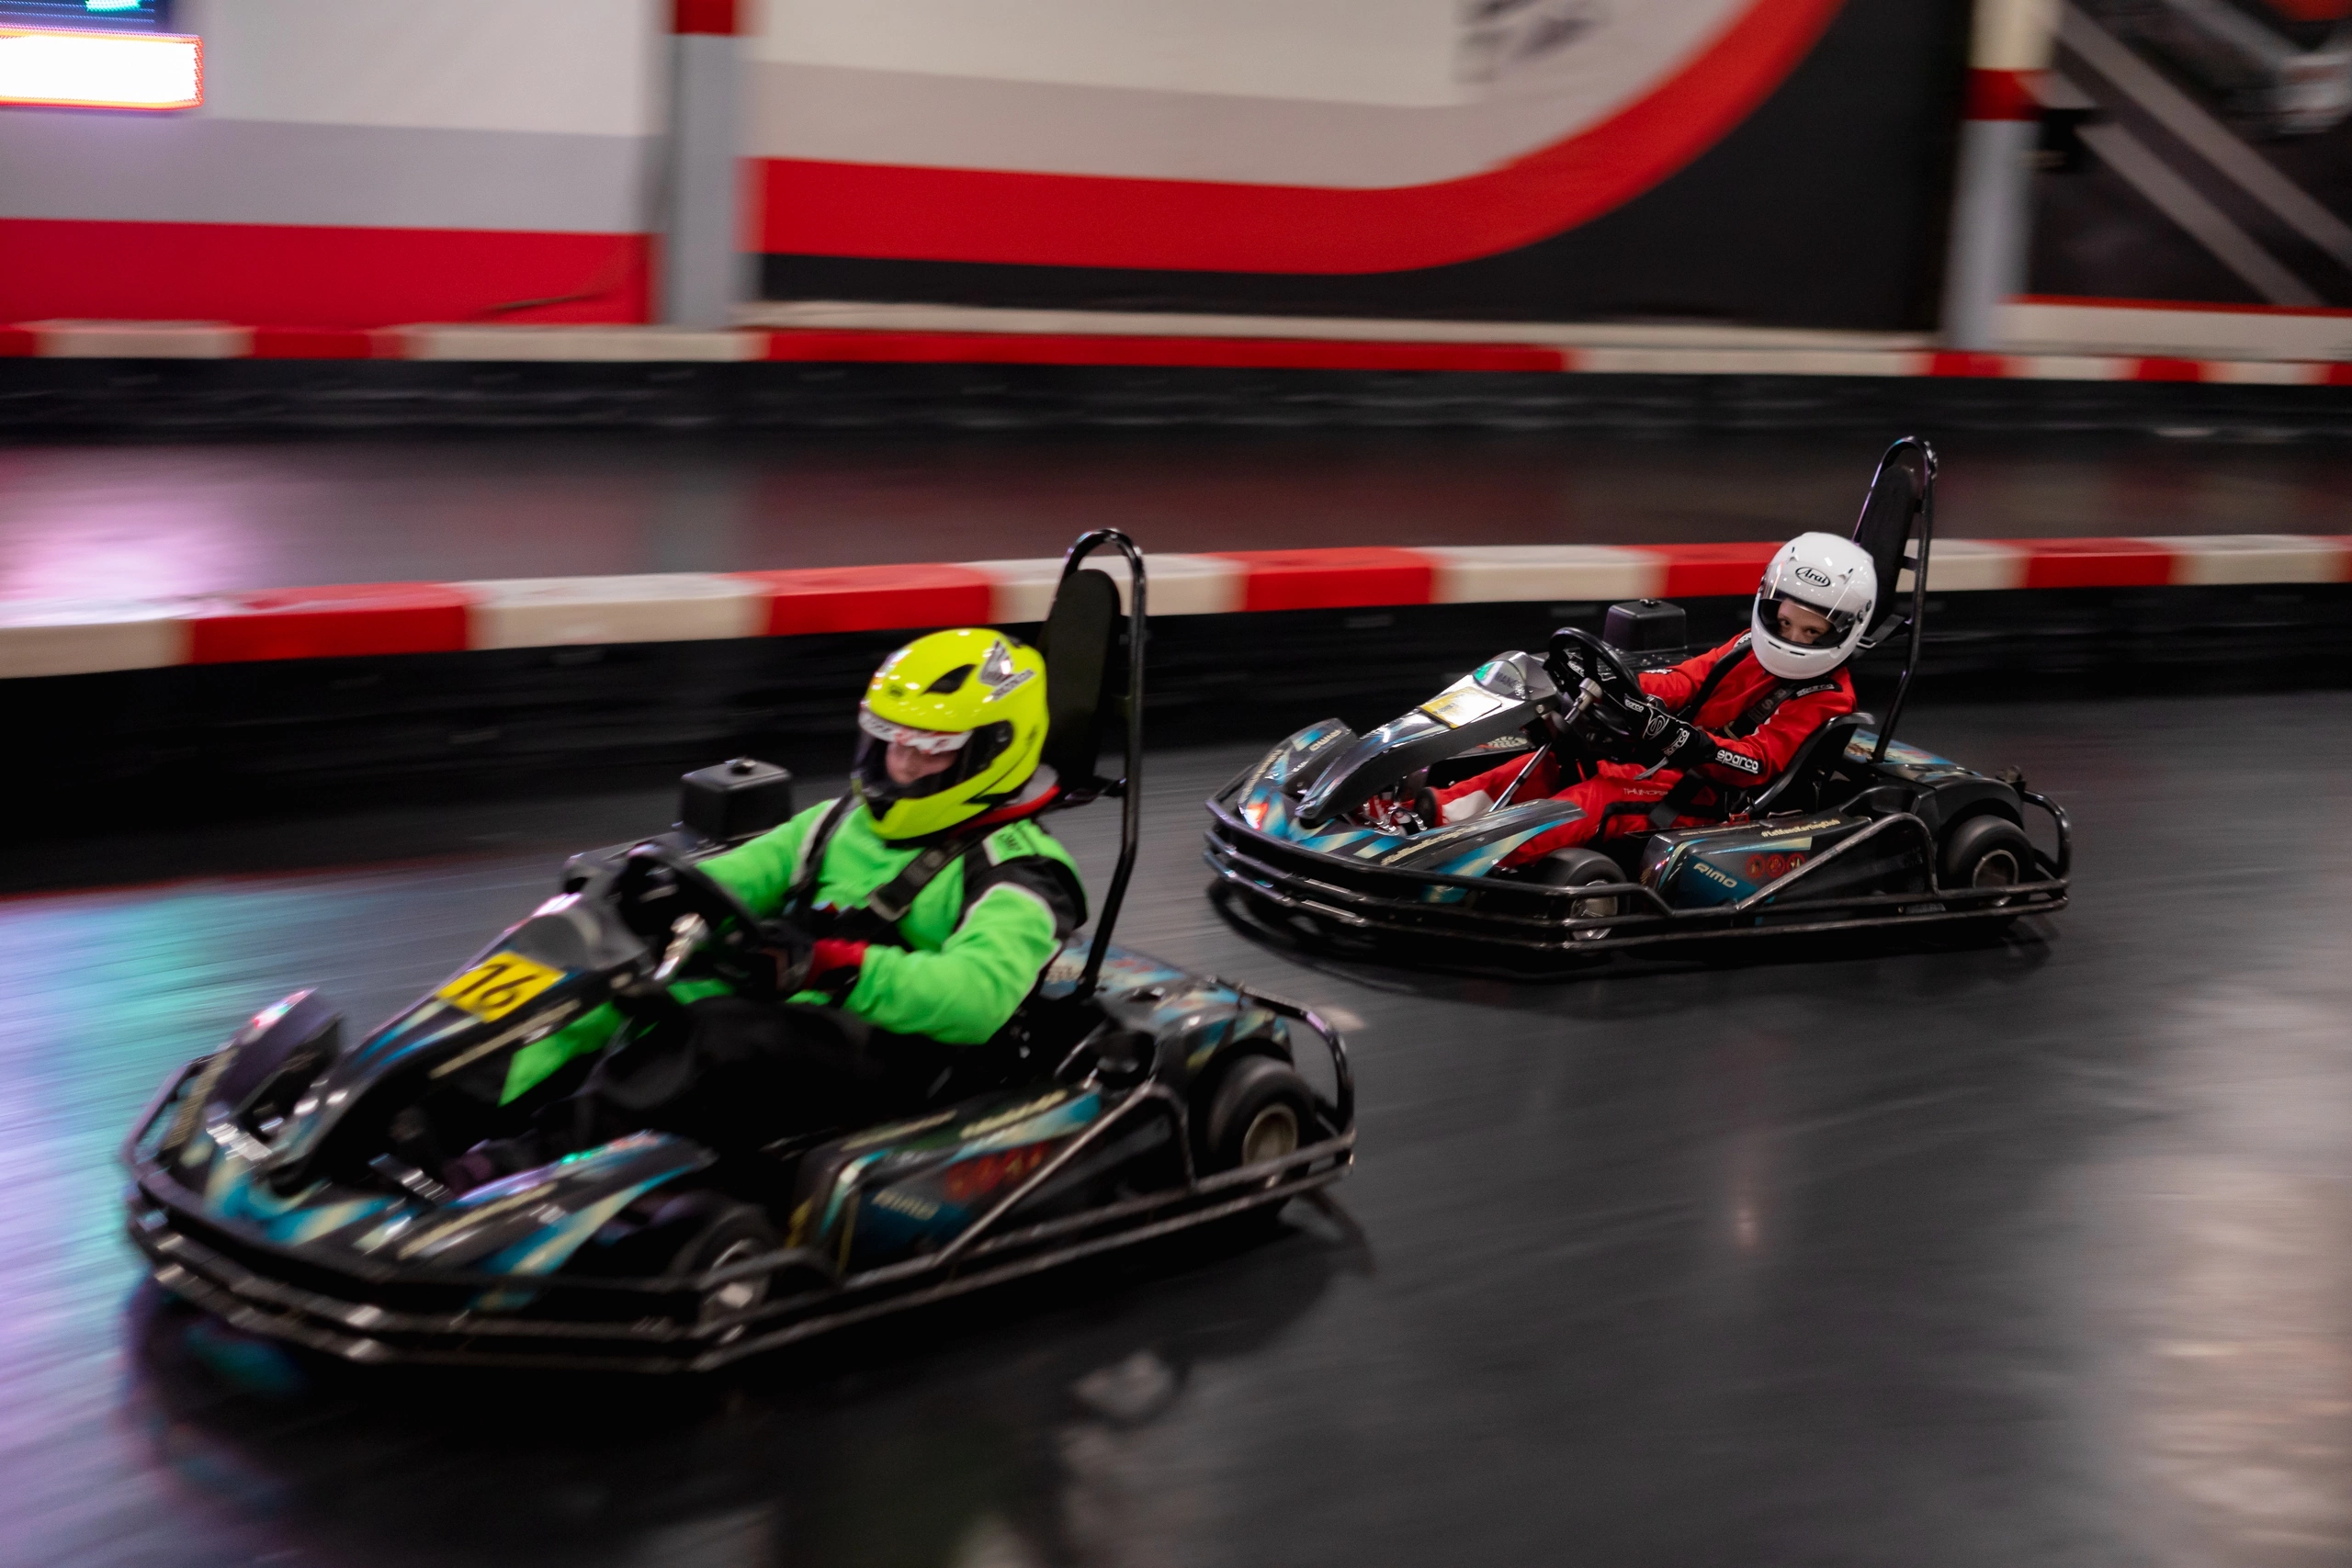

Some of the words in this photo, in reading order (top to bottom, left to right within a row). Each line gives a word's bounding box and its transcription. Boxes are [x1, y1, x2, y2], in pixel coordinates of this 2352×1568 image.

[1798, 569, 1827, 584] Arai
[1715, 749, 1759, 773] sparco
[1693, 863, 1738, 889] RIMO
[456, 963, 539, 1010] 16
